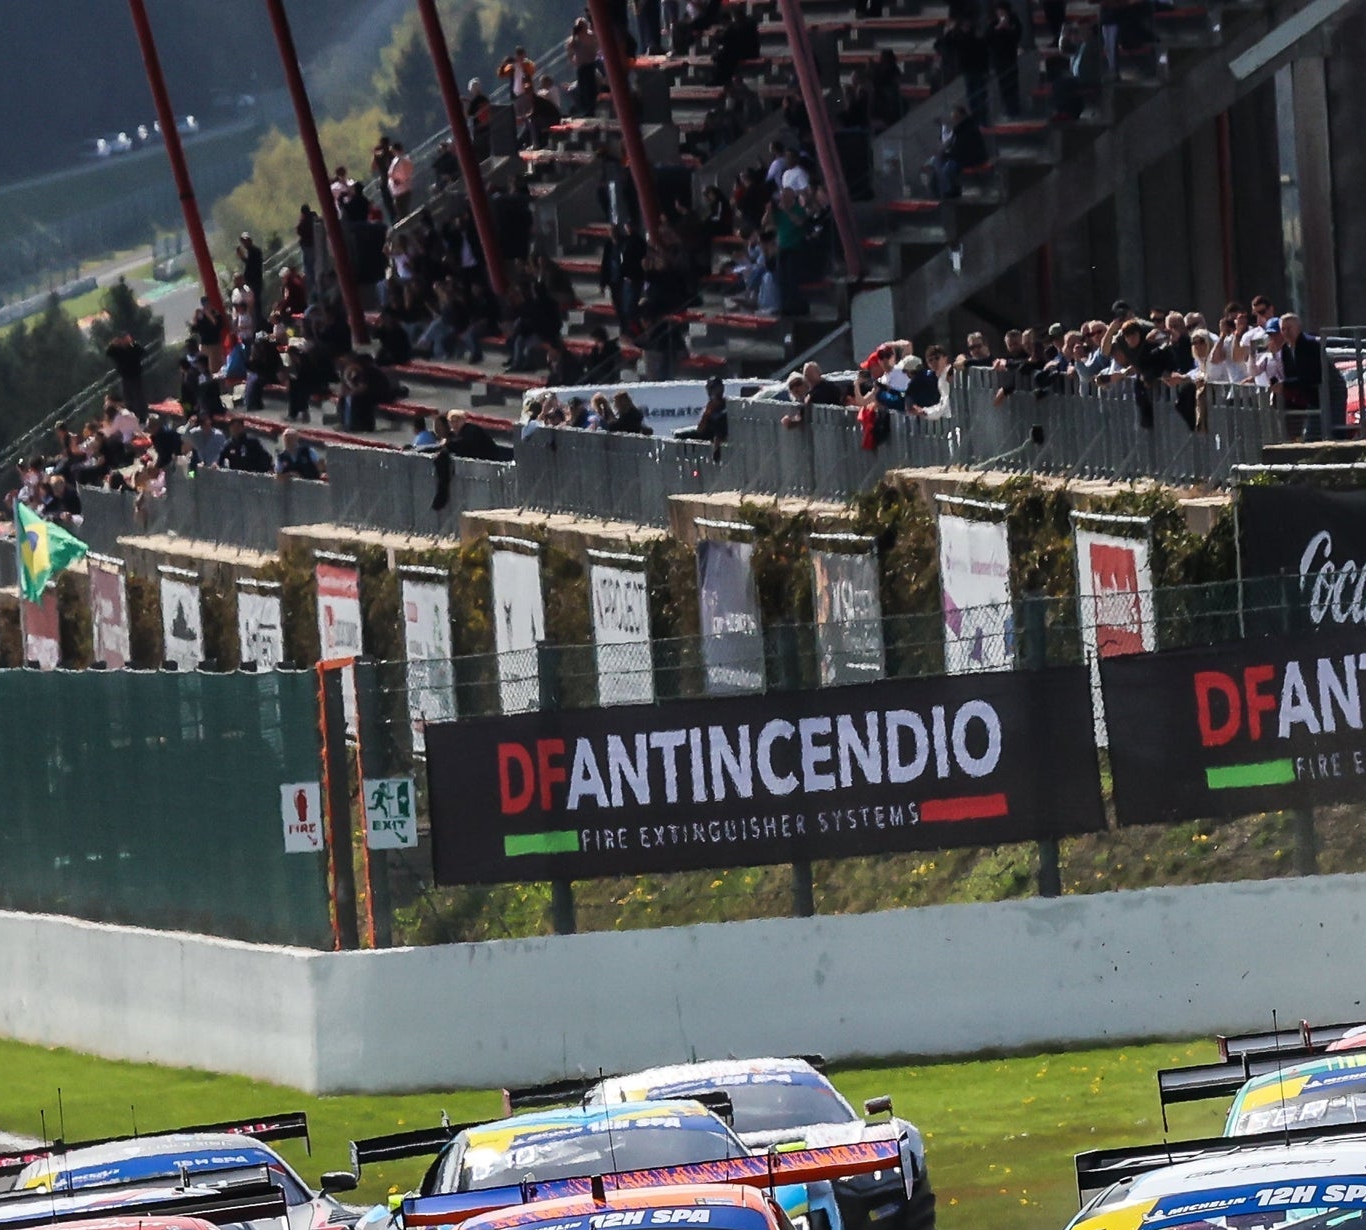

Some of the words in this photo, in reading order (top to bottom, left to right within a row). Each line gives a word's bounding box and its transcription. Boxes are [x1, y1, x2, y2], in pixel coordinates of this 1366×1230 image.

[497, 699, 1003, 815] DFANTINCENDIO
[1296, 754, 1342, 781] FIRE
[289, 823, 317, 834] FIRE
[372, 820, 407, 831] EXIT
[581, 827, 629, 853] FIRE
[639, 812, 807, 848] EXTINGUISHER
[817, 800, 921, 833] SYSTEMS
[586, 1119, 630, 1134] 12H
[634, 1116, 681, 1129] SPA
[1166, 1196, 1248, 1216] MICHELIN
[1254, 1186, 1317, 1207] 12H
[588, 1210, 645, 1230] 12H
[649, 1209, 712, 1225] SPA
